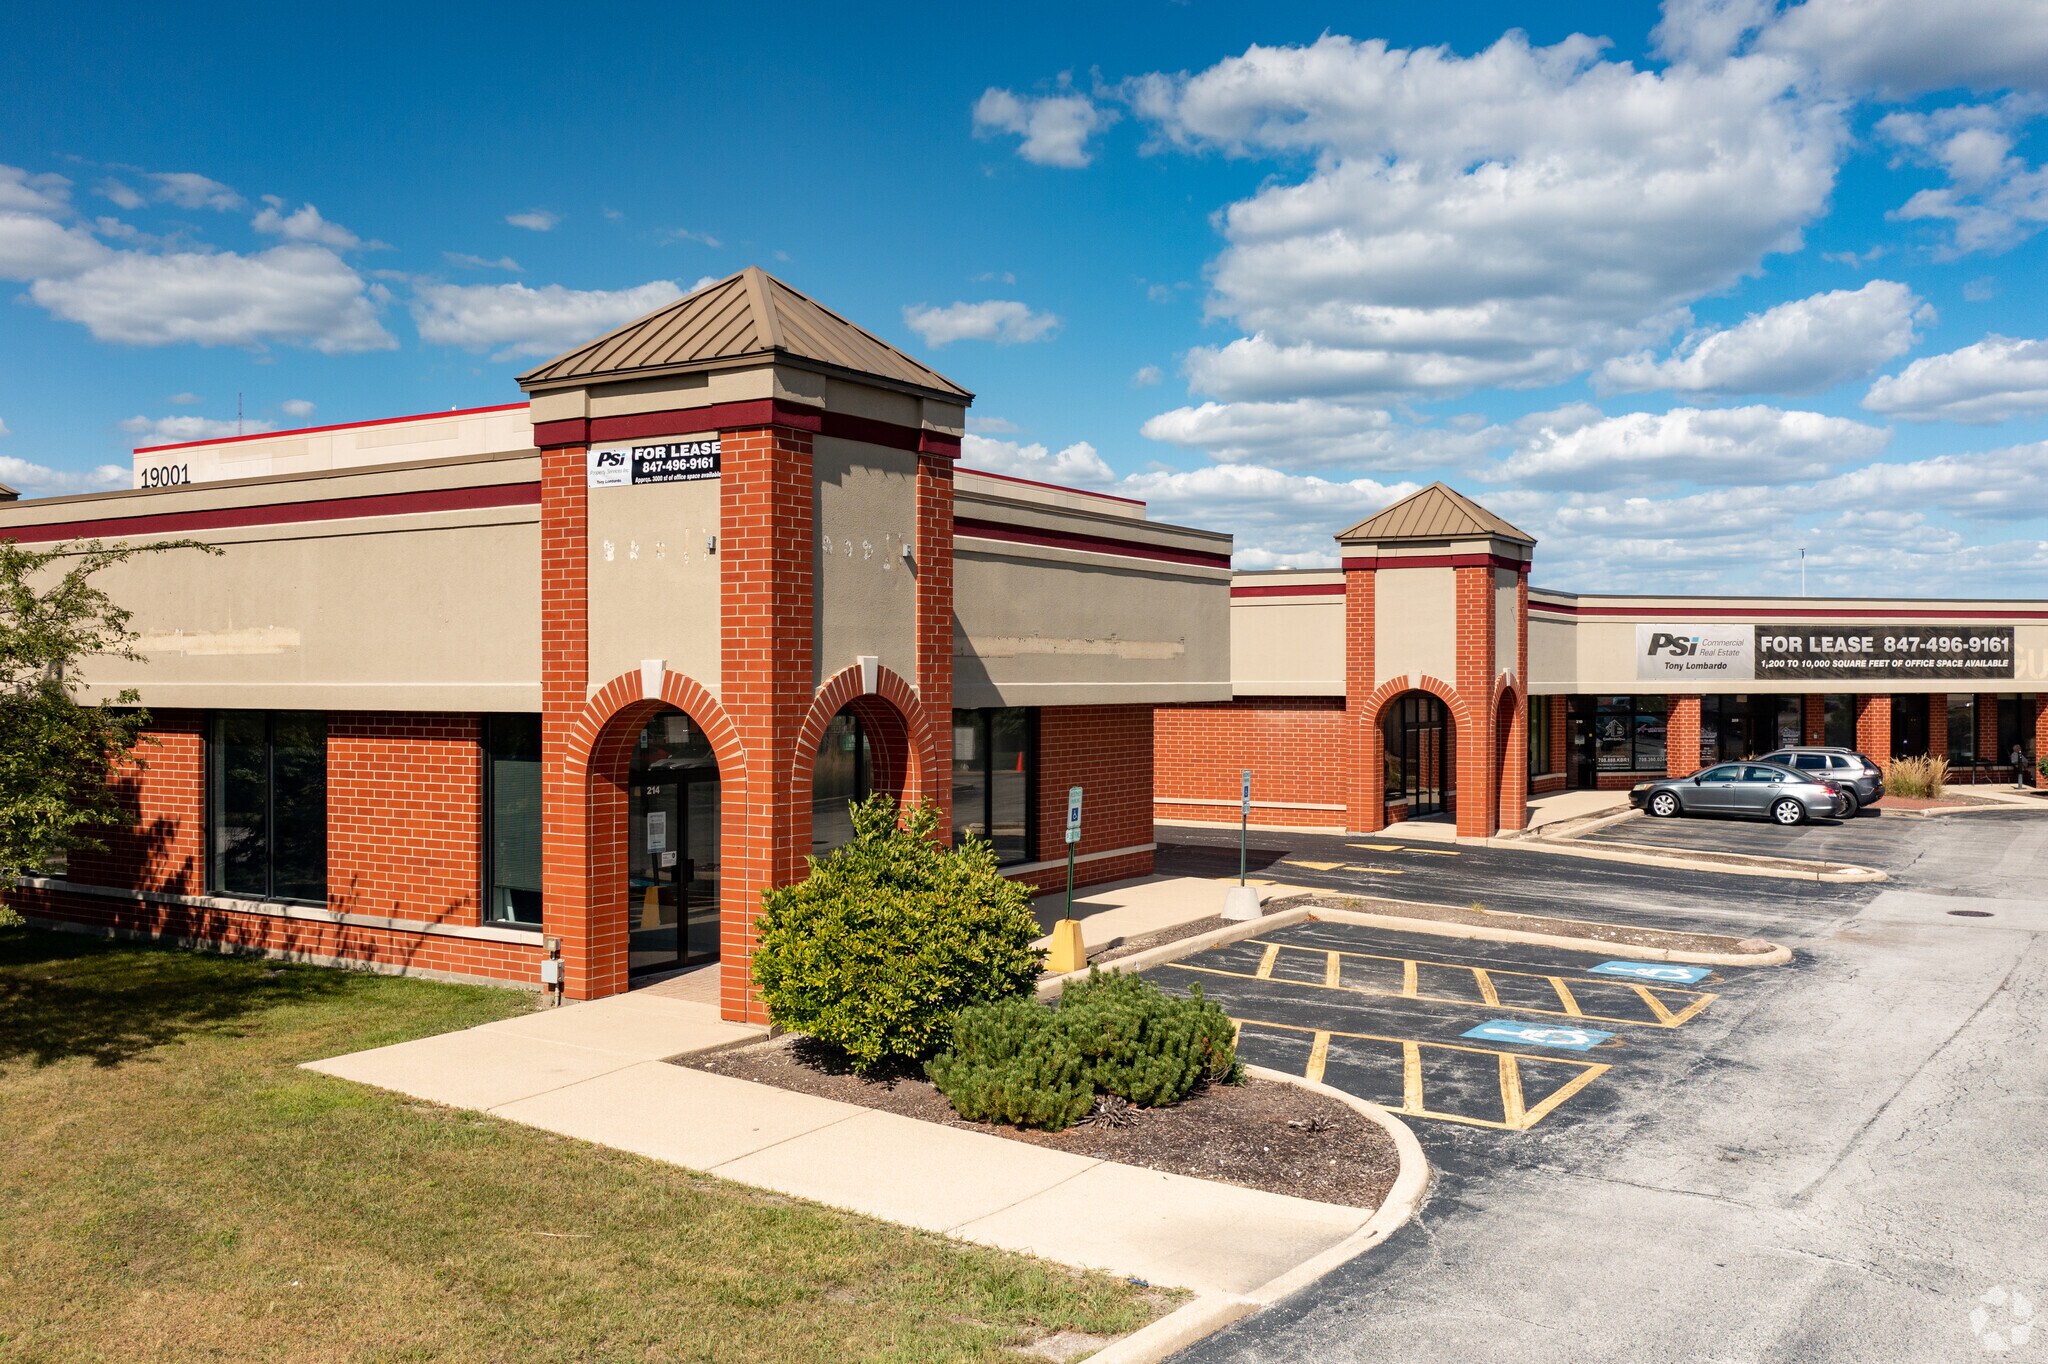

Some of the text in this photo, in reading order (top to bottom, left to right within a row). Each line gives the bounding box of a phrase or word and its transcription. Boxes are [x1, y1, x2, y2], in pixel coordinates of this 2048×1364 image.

[634, 442, 721, 460] FOR LEASE
[642, 457, 714, 473] 847-496-9161
[141, 463, 191, 488] 19001
[1702, 638, 1744, 646] Commercial
[1761, 636, 2009, 653] FOR LEASE 847-496-9161
[1665, 662, 1728, 671] Tony Lombardo
[1761, 660, 2009, 669] 1,200 TO 10,000 SQUARE FEET OF OFFICE SPACE AVAILABLE
[647, 785, 661, 795] 214
